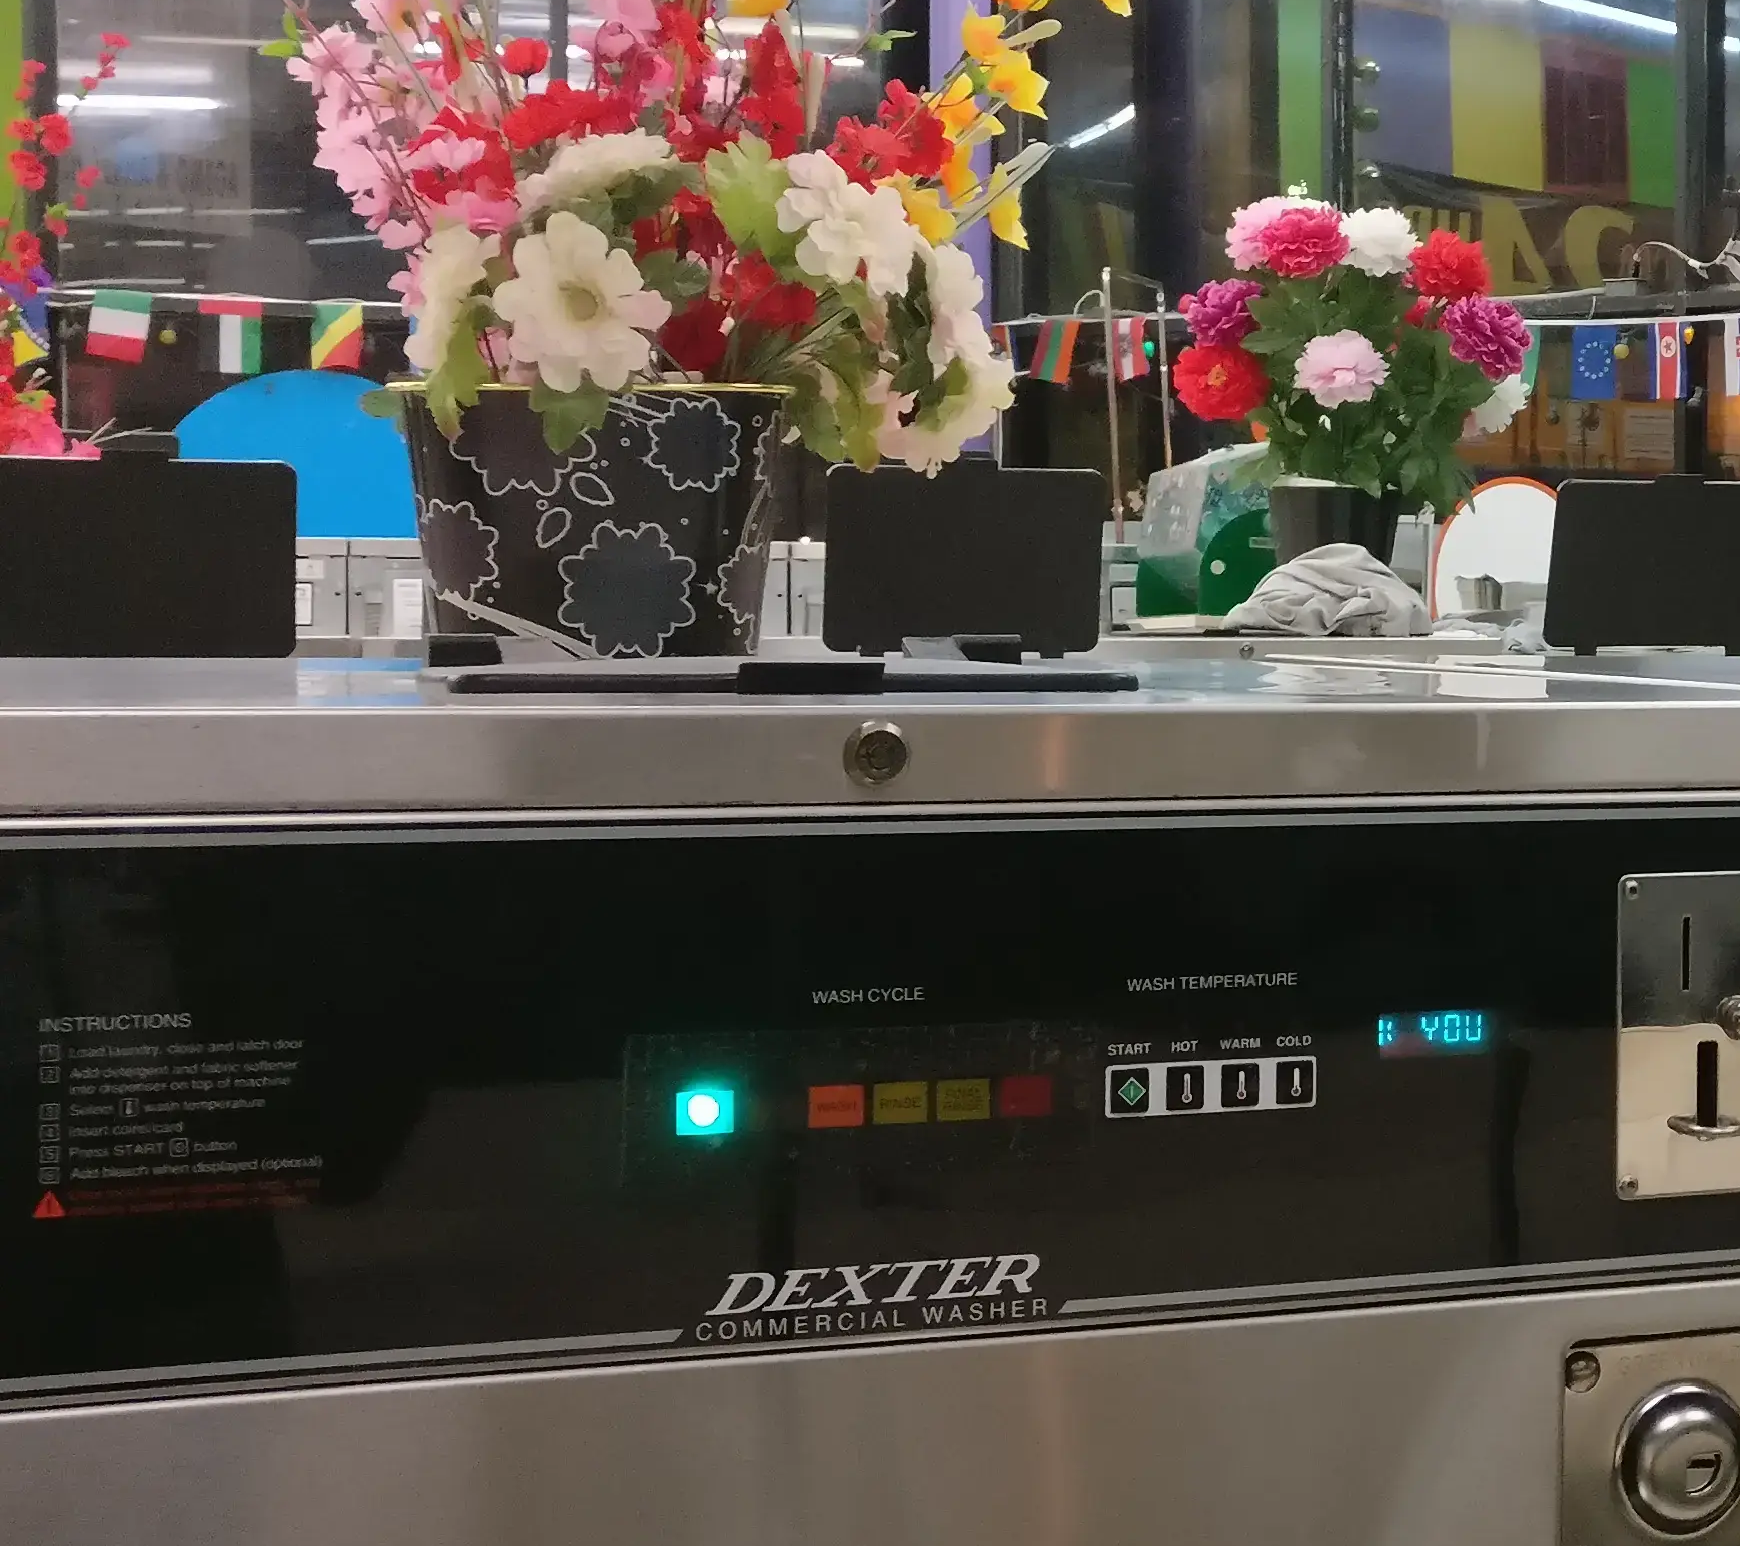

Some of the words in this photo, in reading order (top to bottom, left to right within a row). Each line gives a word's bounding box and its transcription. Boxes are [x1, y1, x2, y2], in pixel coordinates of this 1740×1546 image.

[1127, 977, 1175, 992] WASH
[1179, 972, 1298, 990] TEMPERATURE
[812, 990, 863, 1004] WASH
[868, 987, 926, 1002] CYCLE
[38, 1012, 192, 1033] INSTRUCTIONS
[1421, 1014, 1482, 1042] YOU
[1108, 1042, 1152, 1057] START
[1171, 1040, 1199, 1052] HOT
[1220, 1037, 1261, 1050] WARM
[1276, 1035, 1312, 1047] COLD
[114, 1143, 164, 1156] START
[704, 1252, 1041, 1318] DEXTER
[695, 1306, 906, 1343] COMMERCIAL
[921, 1296, 1050, 1326] WASHER
